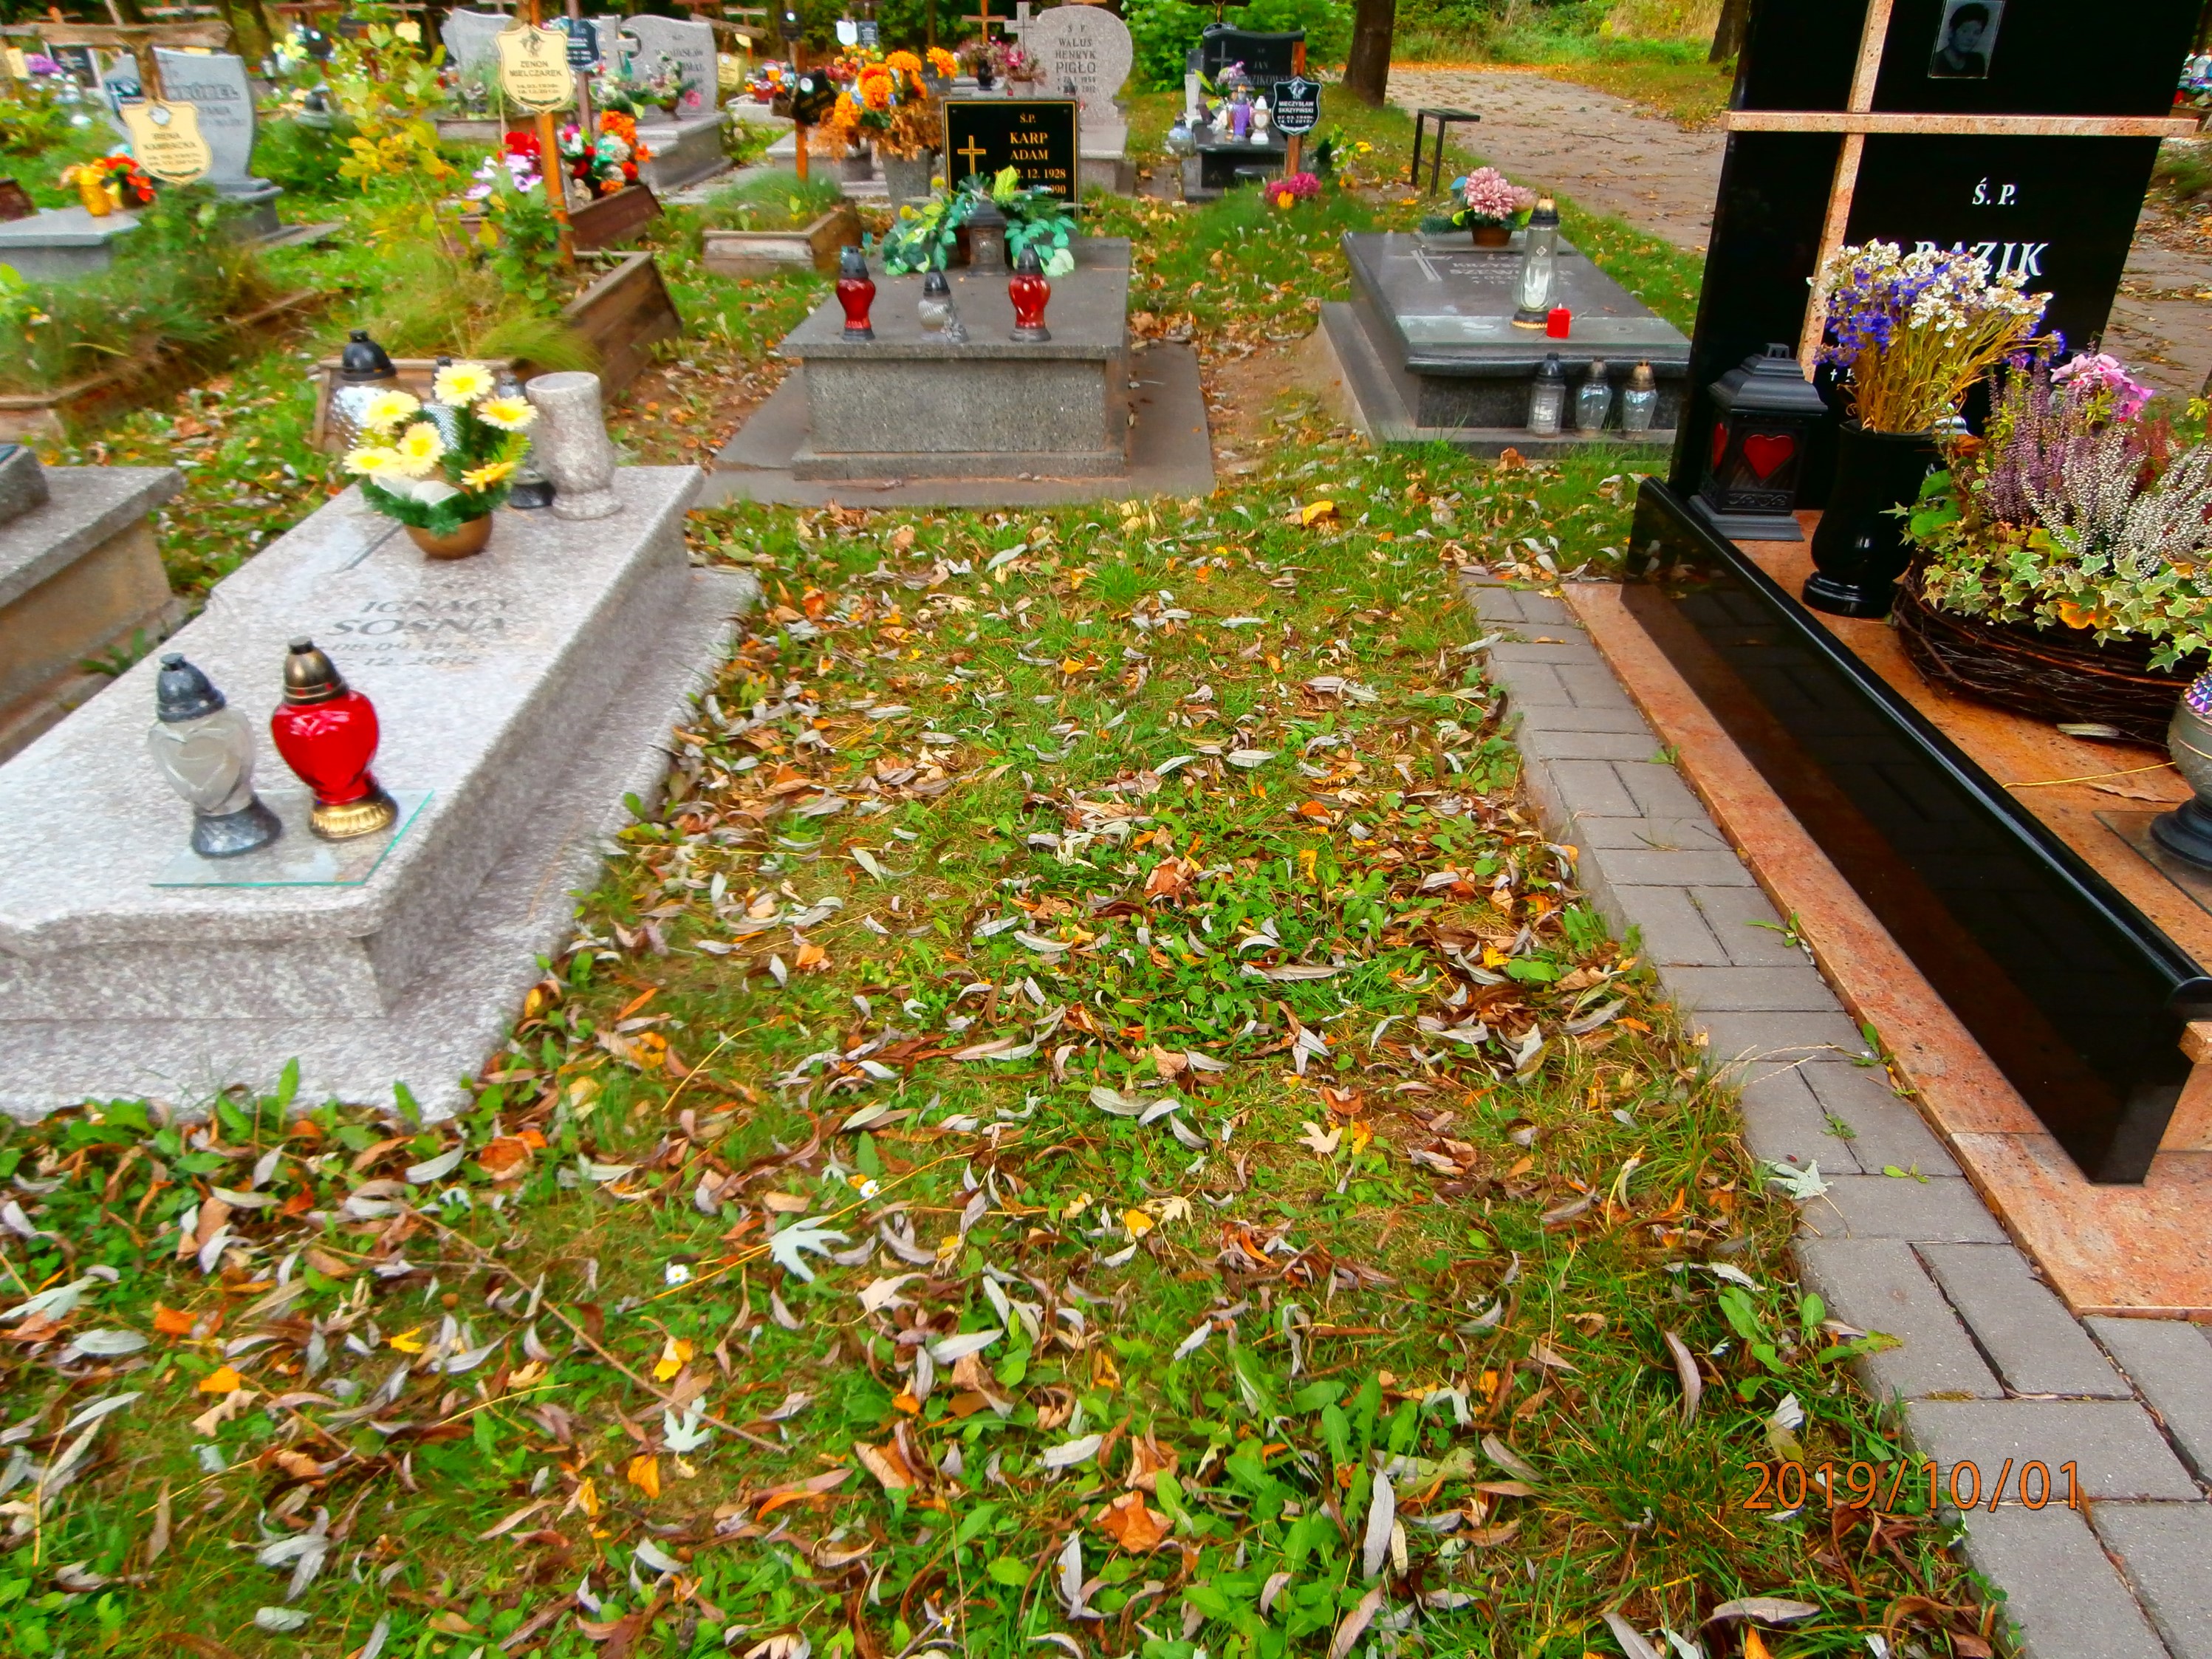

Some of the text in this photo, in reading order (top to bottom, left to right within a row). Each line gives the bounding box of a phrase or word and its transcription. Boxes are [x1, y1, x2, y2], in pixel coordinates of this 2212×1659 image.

[1055, 49, 1096, 59] HENRYK
[1056, 61, 1096, 73] PIGŁO
[509, 69, 563, 77] MIELCZAREK
[1010, 131, 1048, 144] KARP
[1010, 149, 1049, 160] ADAM
[1044, 168, 1066, 179] 1928
[326, 618, 504, 636] SOSNA
